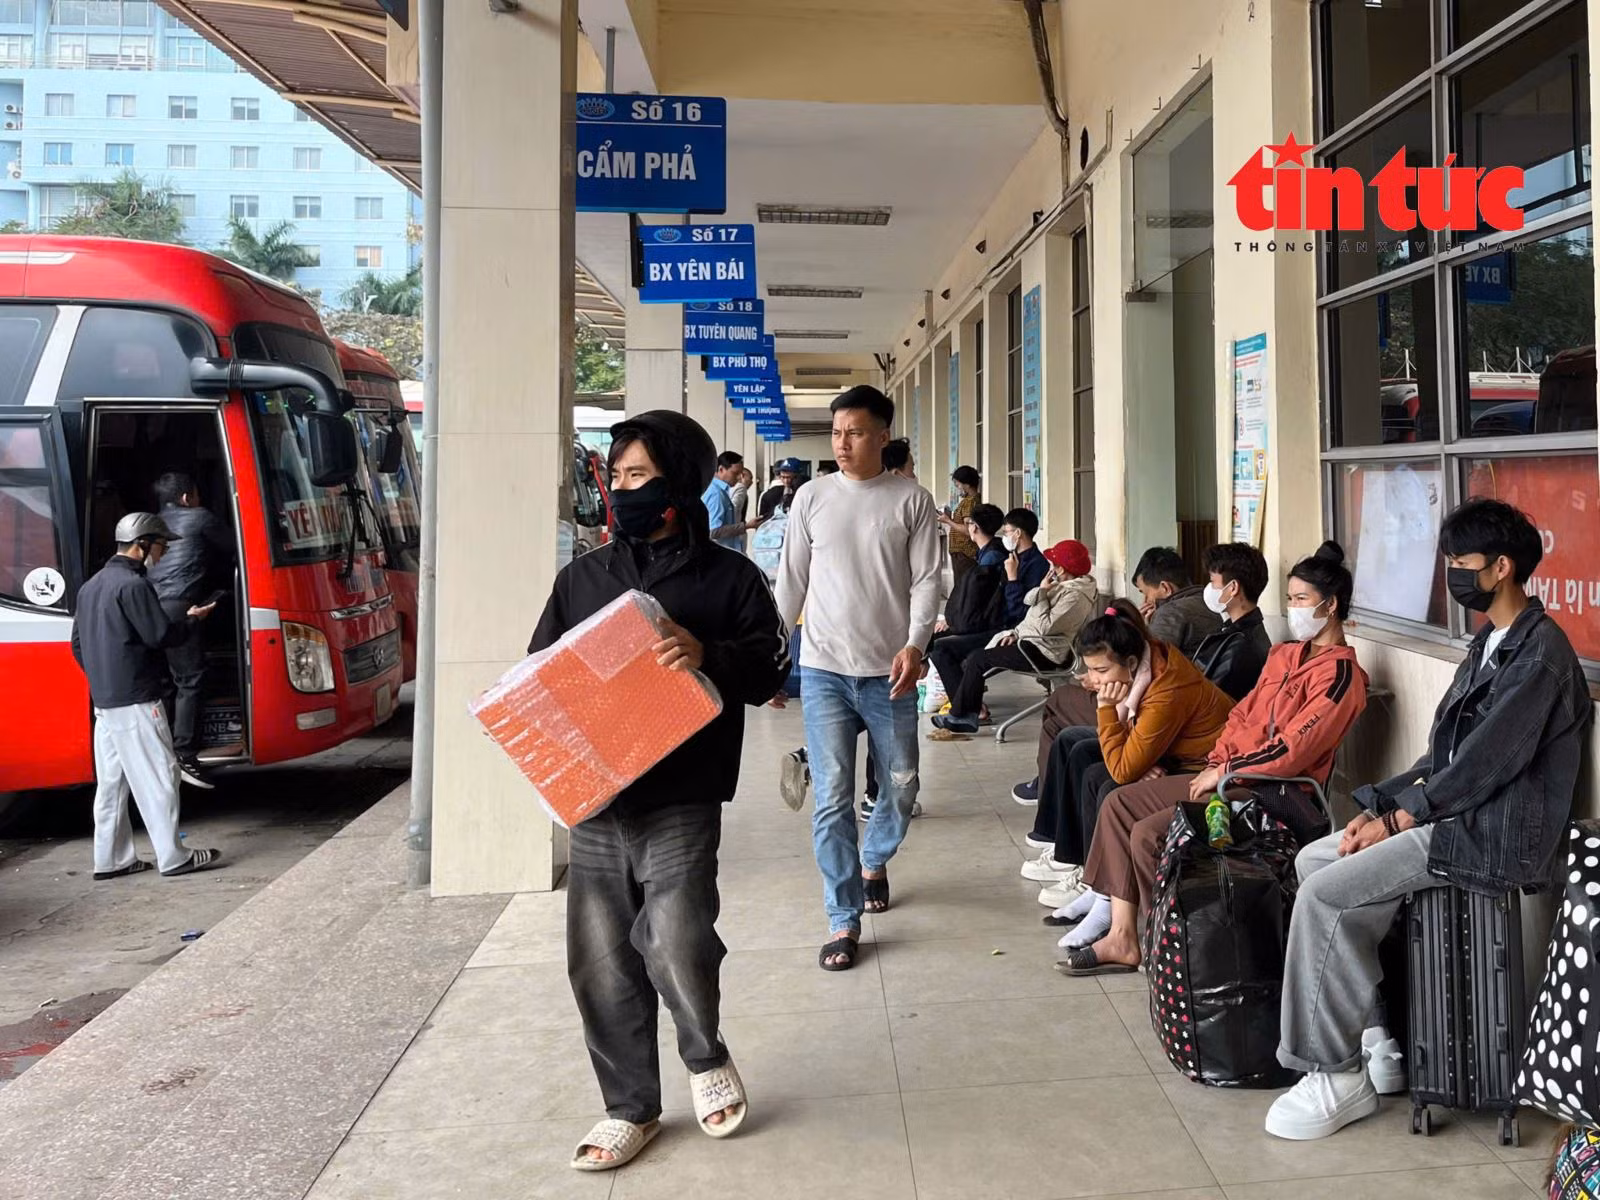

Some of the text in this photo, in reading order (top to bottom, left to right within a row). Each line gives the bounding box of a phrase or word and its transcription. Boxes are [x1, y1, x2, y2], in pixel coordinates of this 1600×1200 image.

[631, 98, 701, 122] Số 16
[577, 139, 697, 180] CẨM PHẢ
[692, 226, 714, 242] Số
[718, 228, 738, 242] 17
[649, 257, 745, 281] BX YÊN BÁI
[738, 301, 753, 312] 18
[684, 322, 757, 341] BX TUYÊN QUANG
[713, 356, 726, 368] BX
